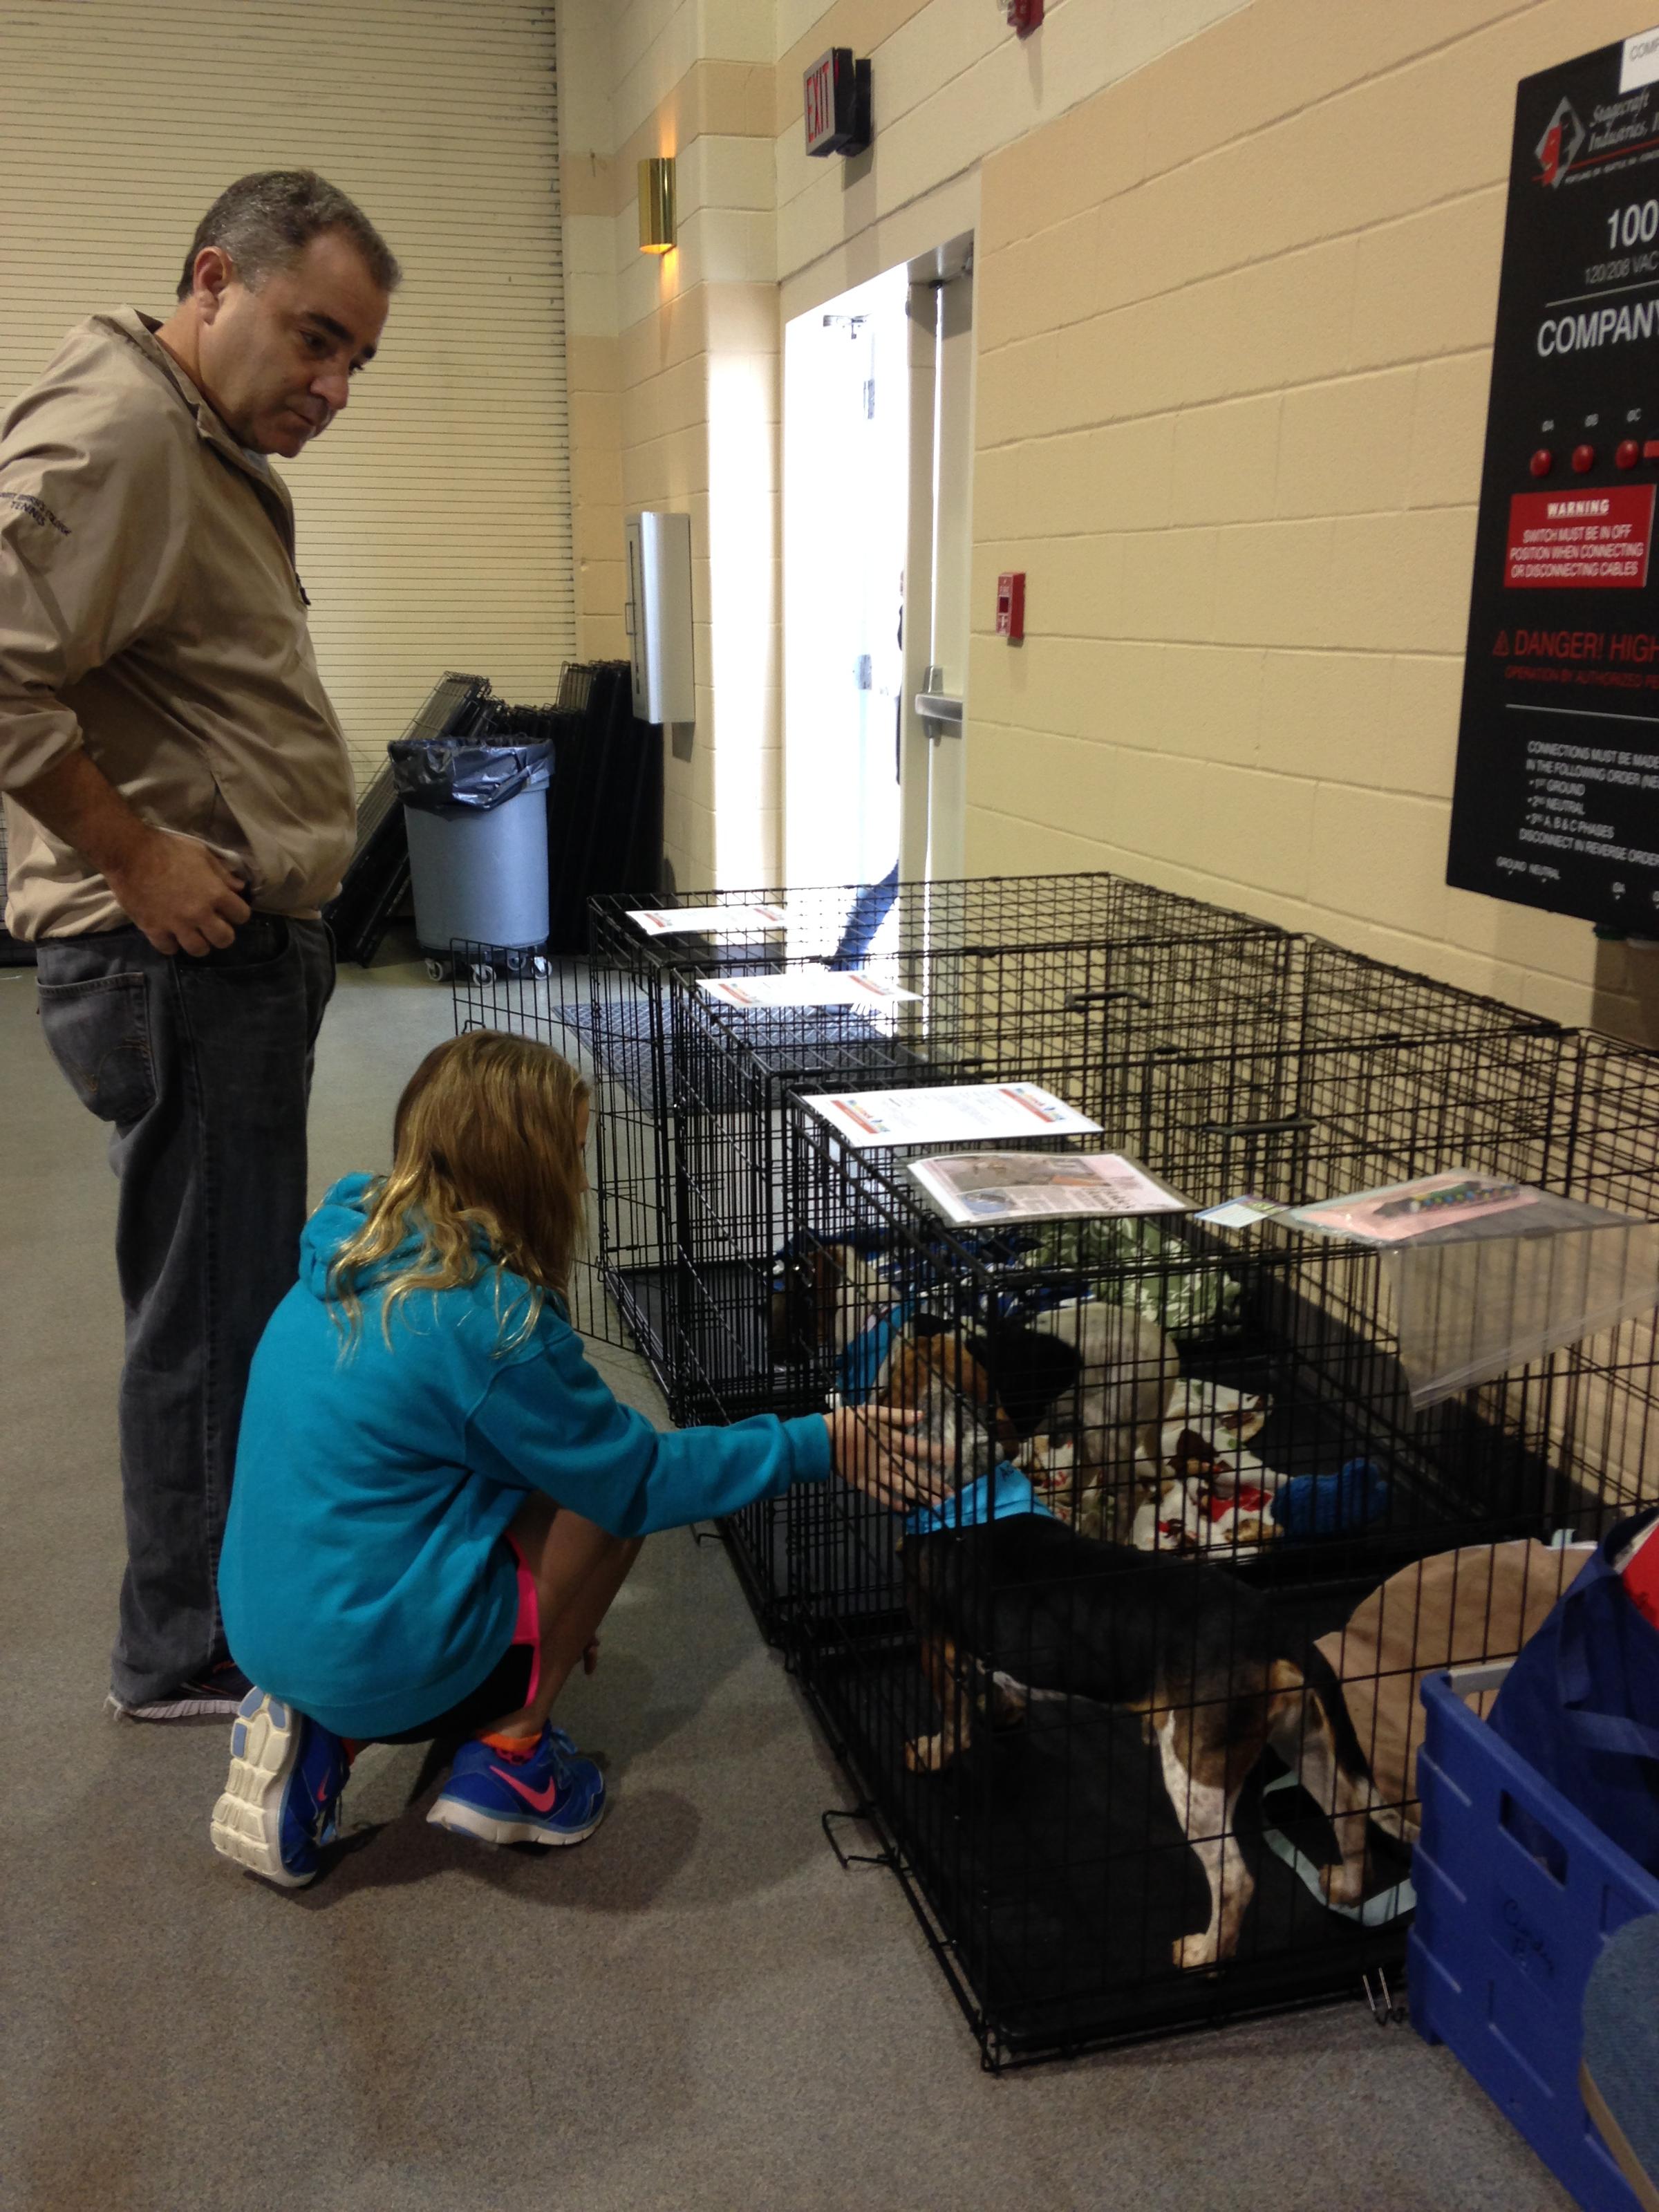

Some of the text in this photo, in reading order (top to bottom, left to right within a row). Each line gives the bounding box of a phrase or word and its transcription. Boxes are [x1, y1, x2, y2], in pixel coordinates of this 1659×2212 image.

[807, 61, 830, 143] EXIT
[10, 500, 45, 527] TENNIS
[1547, 498, 1609, 517] WARNING
[1523, 524, 1632, 543] SWITCH MUST BE IN OFF
[1510, 542, 1644, 561] POSITION WHEN CONNECTING
[1510, 561, 1638, 578] OR DISCONNECTING CABLES
[1515, 629, 1604, 659] DANGER!
[1527, 740, 1591, 760] CONNECTIONS
[1591, 748, 1618, 763] MUST
[1618, 751, 1632, 765] BE
[1537, 759, 1555, 774] THE
[1554, 762, 1606, 781] FOLLOWING
[1606, 769, 1641, 785] ORDER
[1546, 779, 1586, 796] GROUND
[1546, 797, 1586, 816] NEUTRAL
[1577, 821, 1615, 839] PHASES
[1519, 828, 1574, 850] DISCONNECT
[1584, 840, 1628, 861] REVERSE
